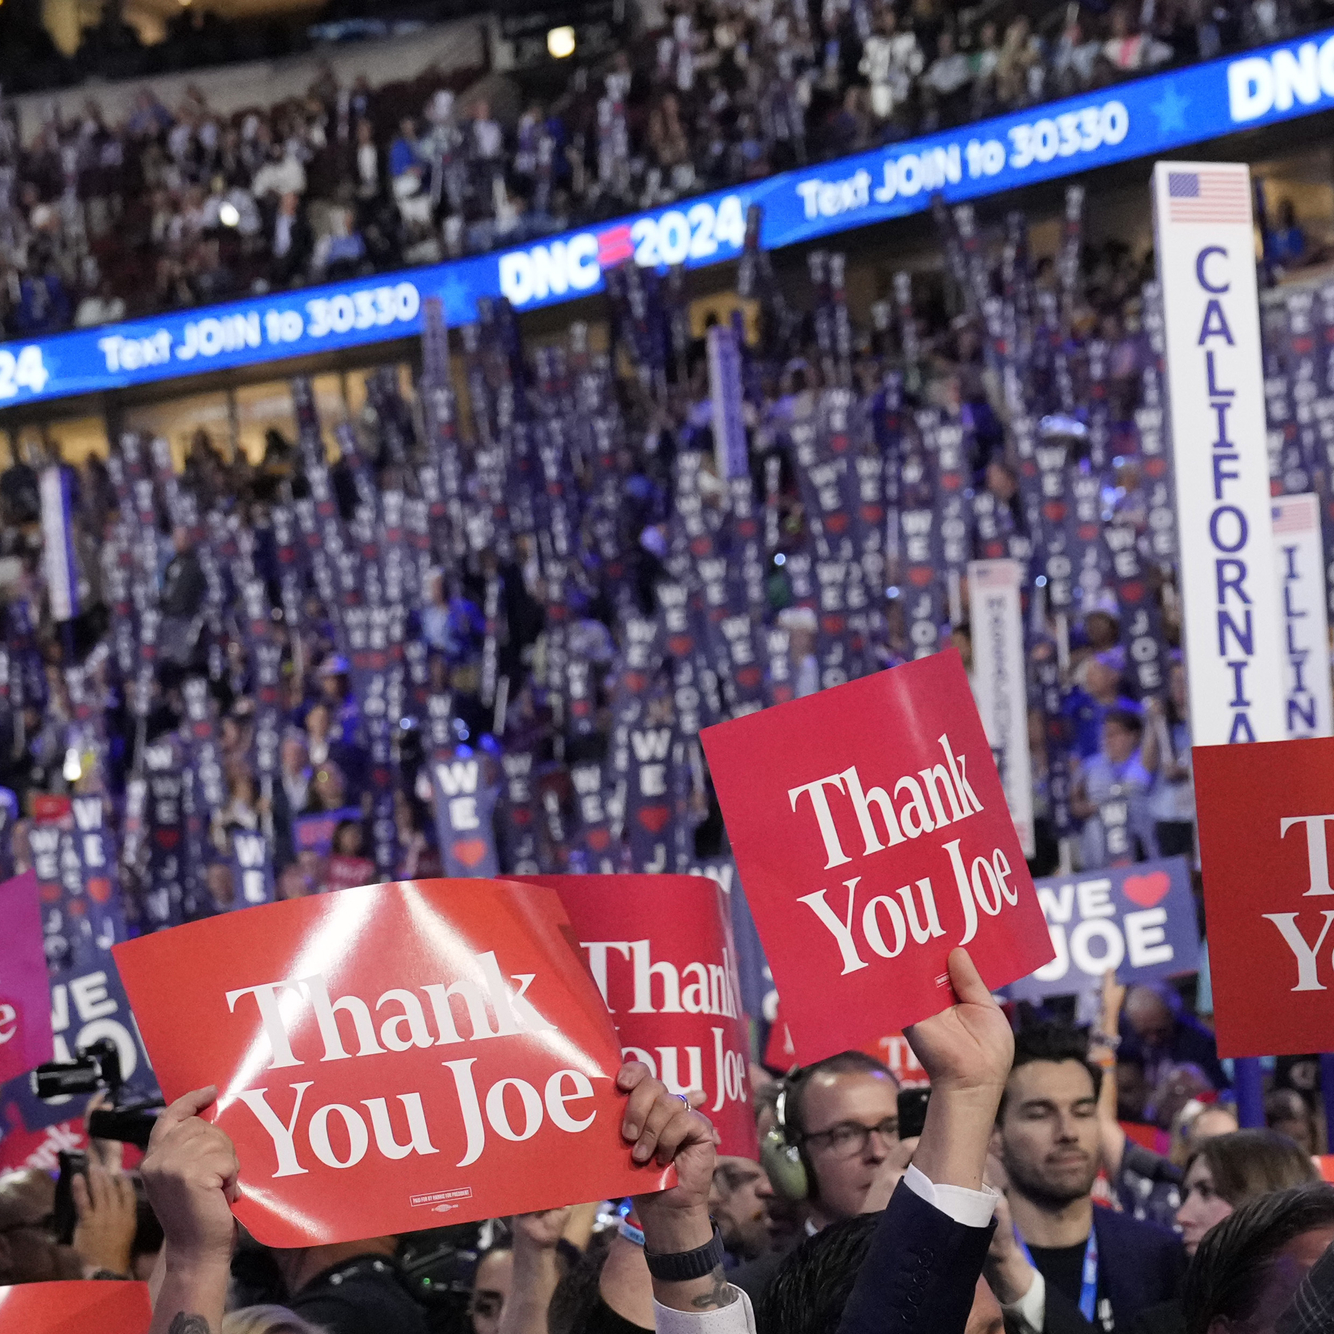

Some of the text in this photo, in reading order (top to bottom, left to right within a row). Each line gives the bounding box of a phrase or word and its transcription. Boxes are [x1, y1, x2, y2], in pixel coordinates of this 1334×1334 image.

[798, 101, 1129, 220] Text JOIN to 30330
[499, 195, 747, 305] DNC 2024
[100, 282, 420, 374] Text JOIN to 30330
[1194, 245, 1259, 743] CALIFORNIA
[1280, 544, 1317, 738] ILLIN
[435, 758, 481, 831] WE
[630, 728, 671, 797] WE
[789, 734, 983, 869] Thank
[72, 799, 104, 867] WE
[797, 839, 1017, 976] You Joe
[1038, 879, 1113, 924] WE
[225, 950, 558, 1071] Thank
[236, 1057, 598, 1179] You Joe
[620, 1026, 747, 1112] ou Joe
